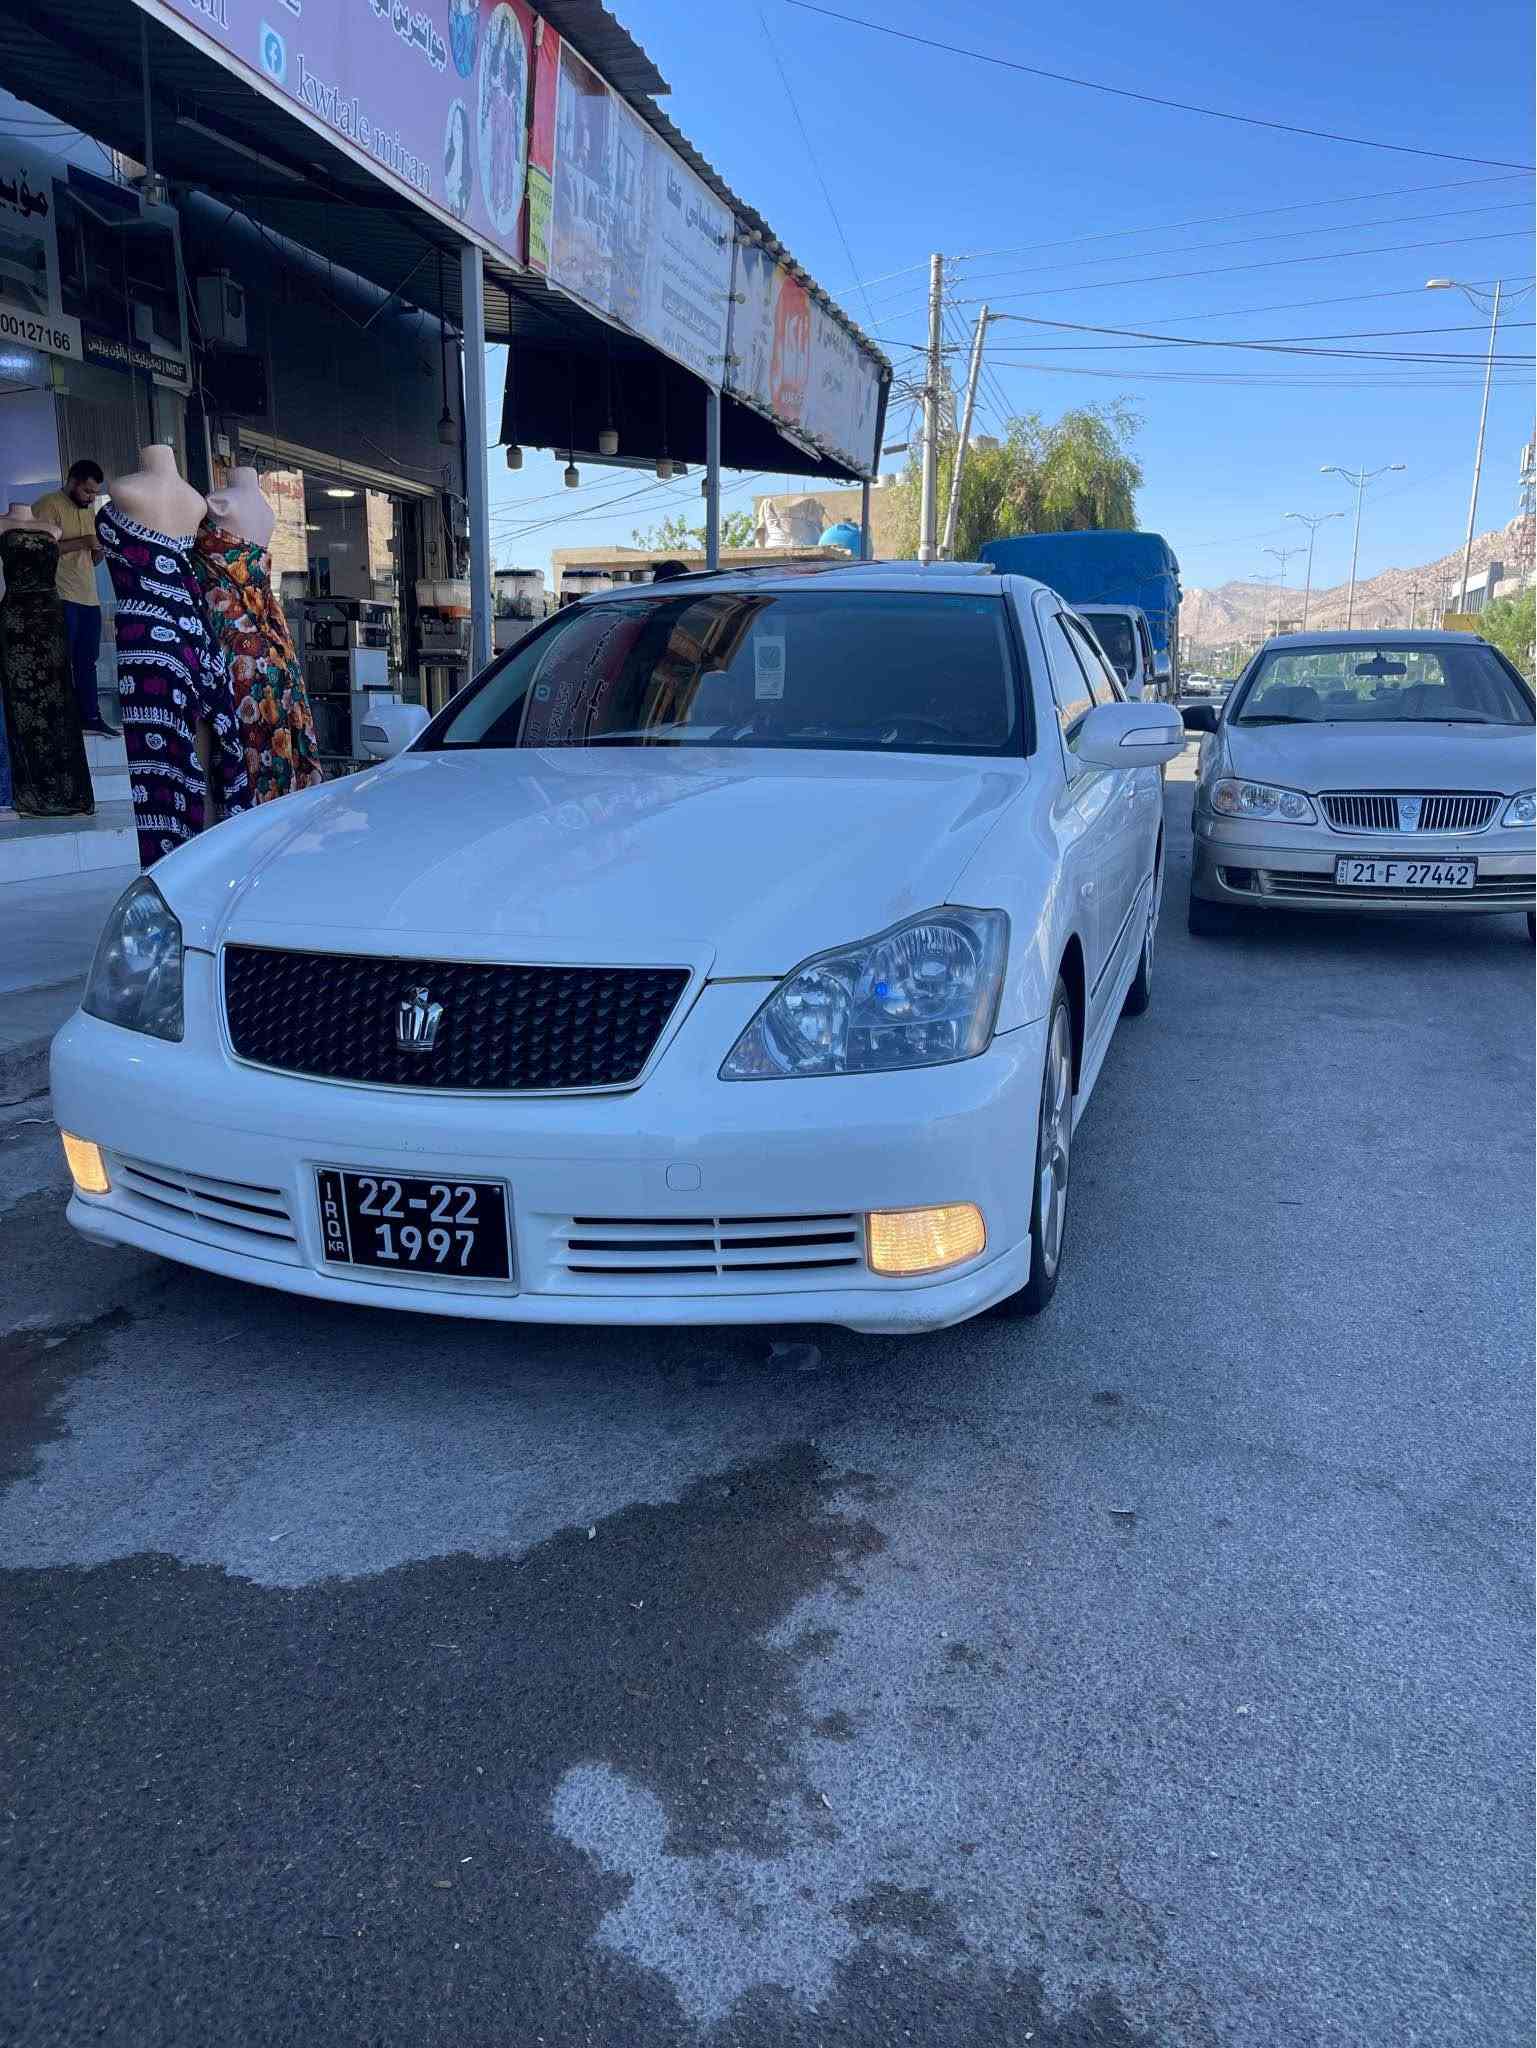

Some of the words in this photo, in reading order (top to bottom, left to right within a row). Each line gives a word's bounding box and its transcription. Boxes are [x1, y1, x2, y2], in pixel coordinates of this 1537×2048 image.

[296, 53, 370, 146] kwtale
[374, 126, 432, 196] miran
[165, 361, 184, 377] MDF
[1353, 863, 1376, 882] 21
[1385, 864, 1398, 883] F
[1406, 864, 1469, 885] 27442
[358, 1177, 480, 1225] 22-22
[328, 1239, 345, 1253] KR
[375, 1223, 475, 1267] 1997
